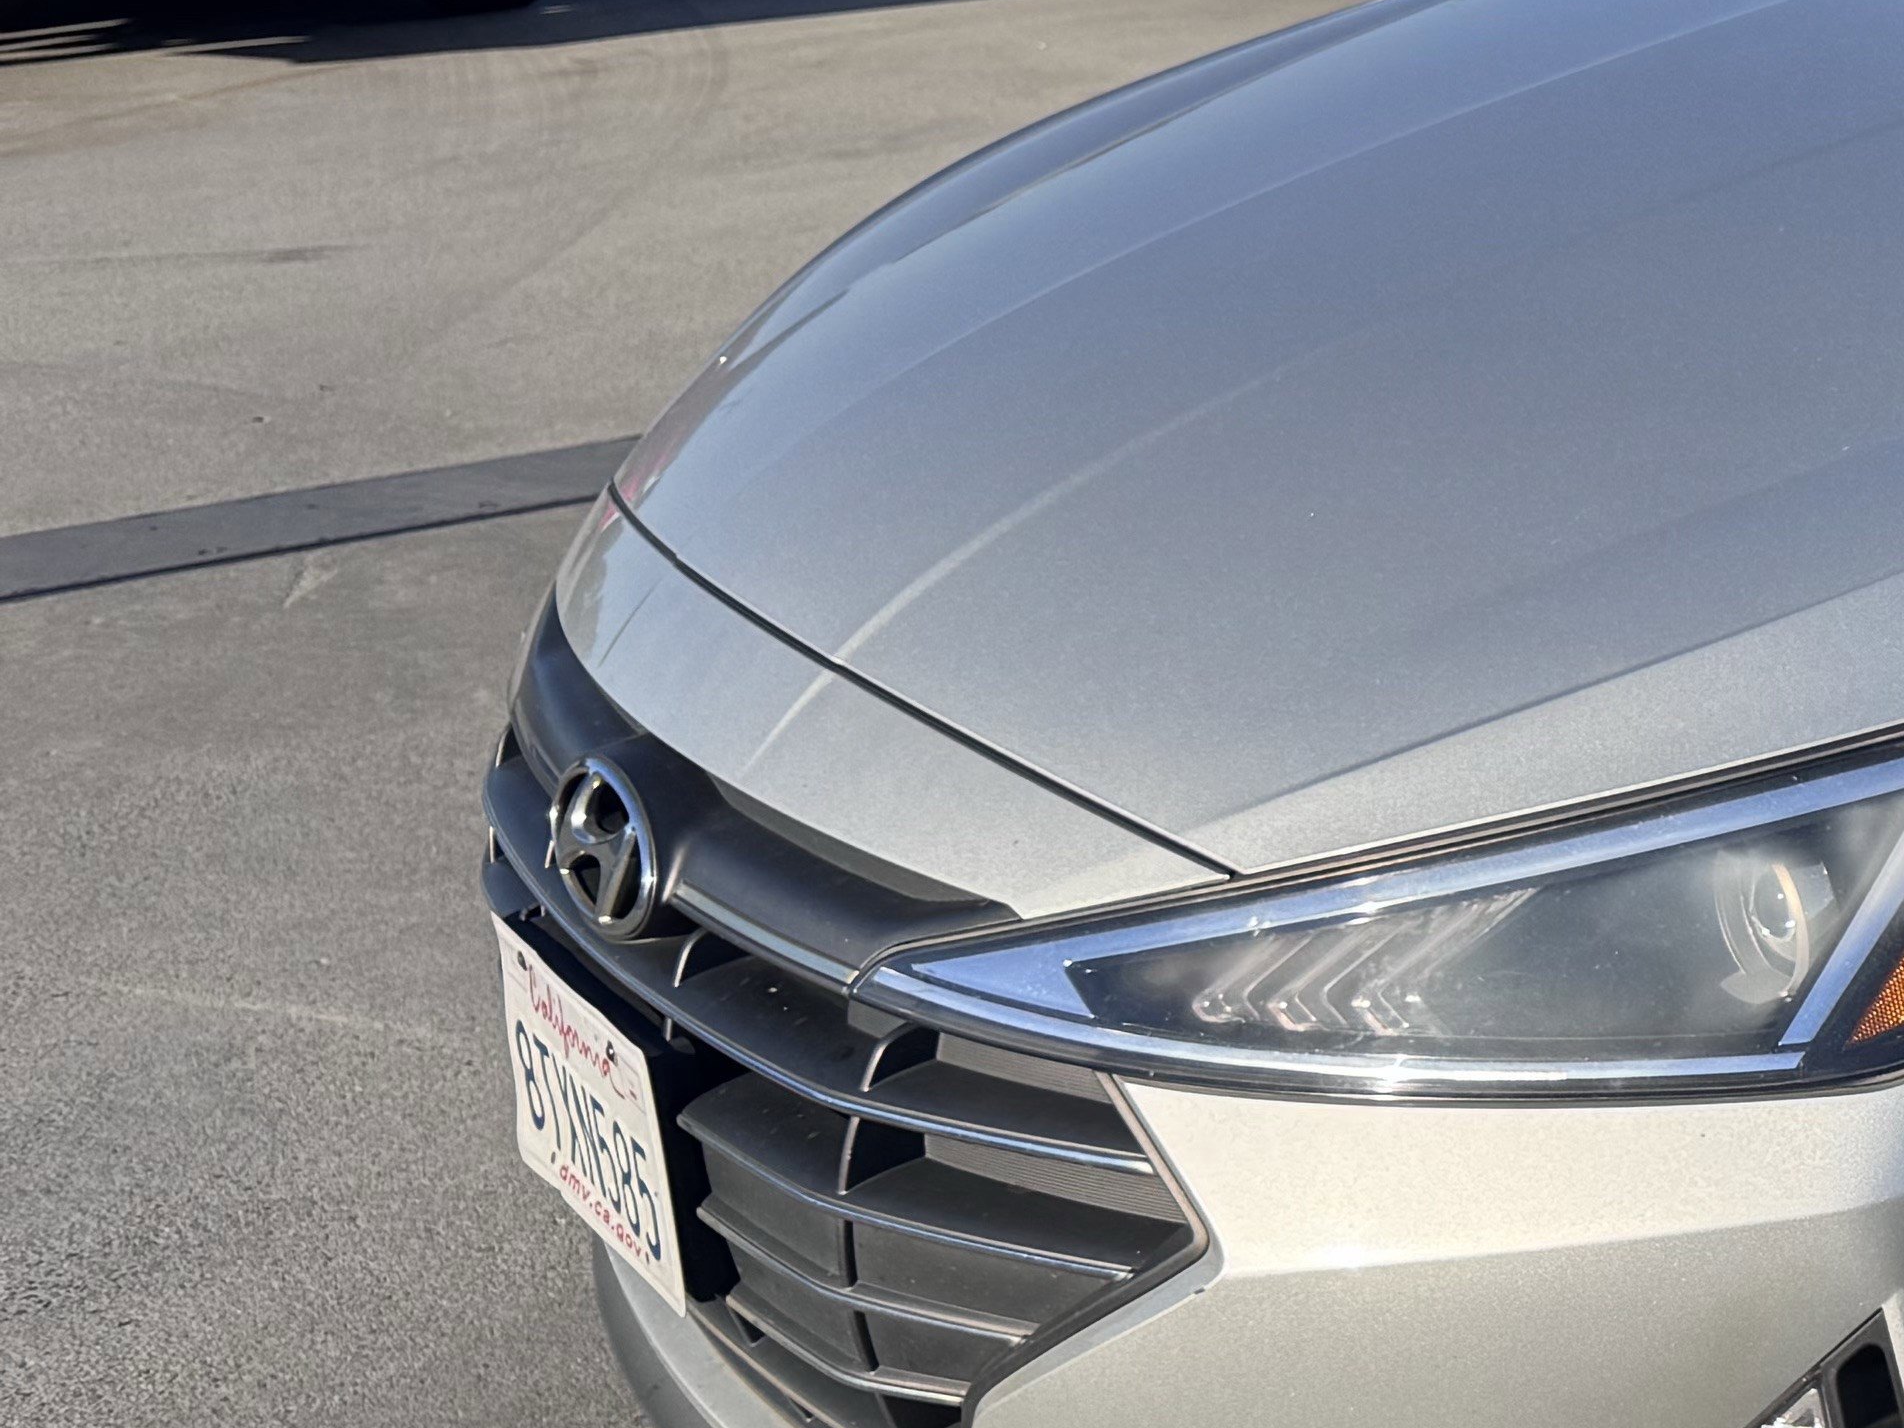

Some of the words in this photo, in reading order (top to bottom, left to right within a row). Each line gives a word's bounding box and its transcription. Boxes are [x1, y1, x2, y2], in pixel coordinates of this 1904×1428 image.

[527, 963, 627, 1100] California
[515, 1018, 662, 1262] 8TXN585
[559, 1163, 642, 1259] dmv.ca.gov
